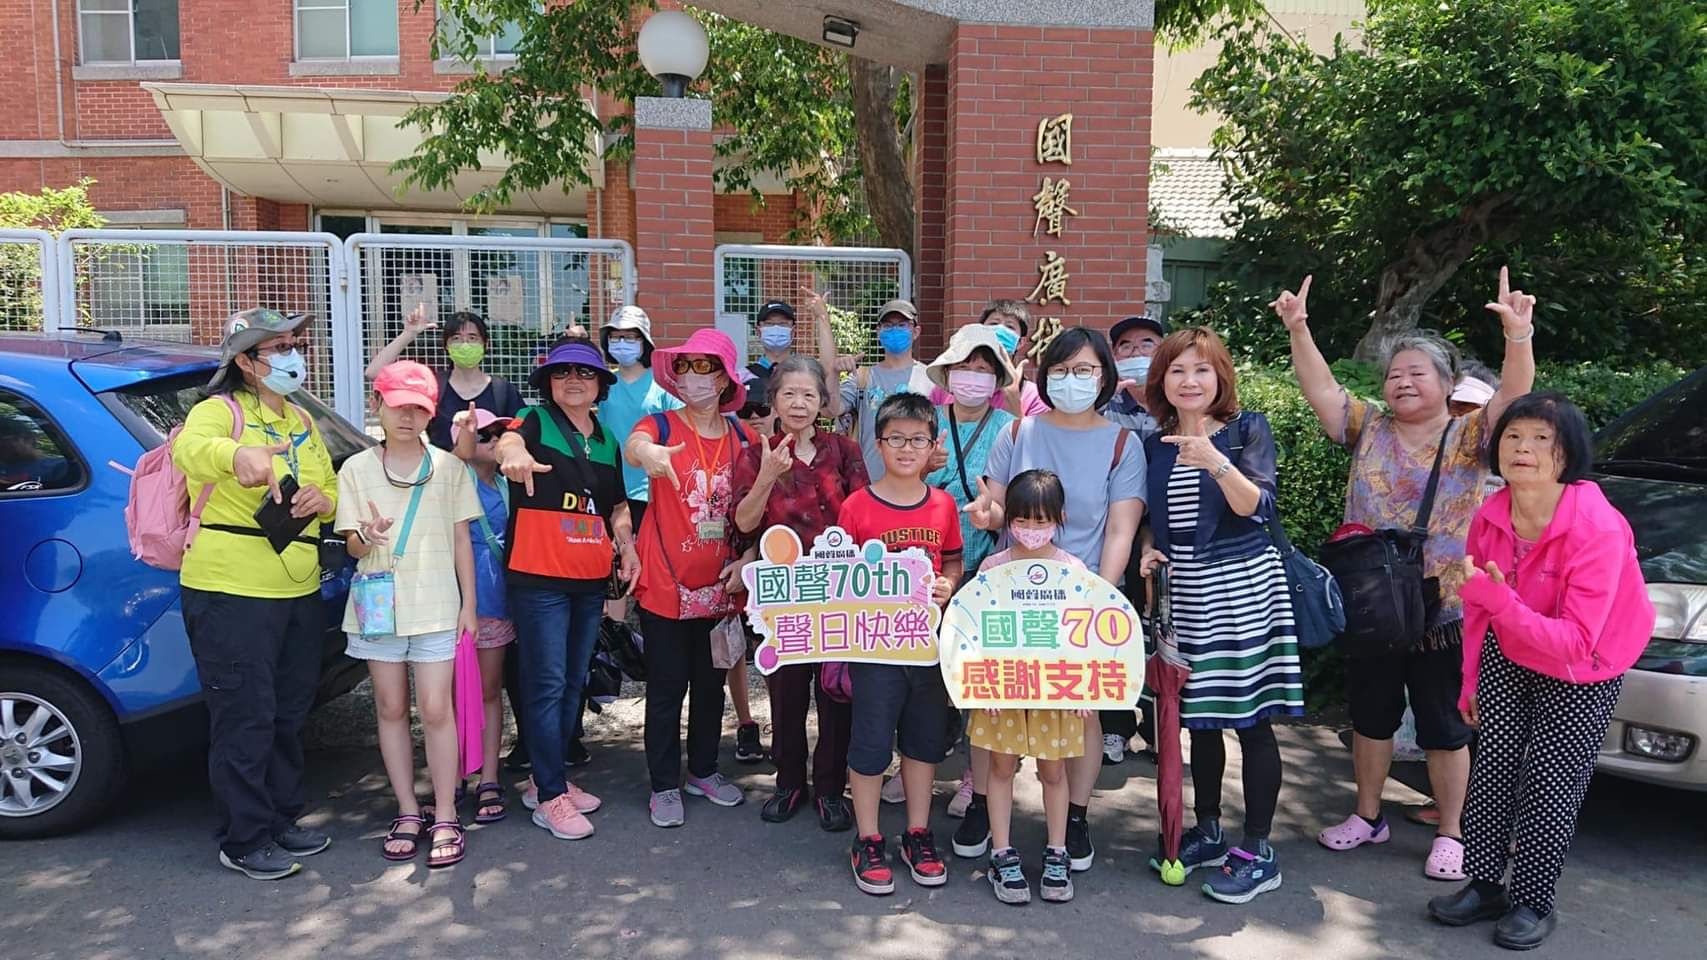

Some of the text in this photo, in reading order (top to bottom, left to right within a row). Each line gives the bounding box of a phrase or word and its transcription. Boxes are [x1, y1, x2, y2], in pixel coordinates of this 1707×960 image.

[756, 562, 909, 604] 國聲70th
[776, 609, 929, 653] 聲日快樂
[981, 607, 1132, 649] 國聲70
[962, 659, 1127, 700] 感謝支持
